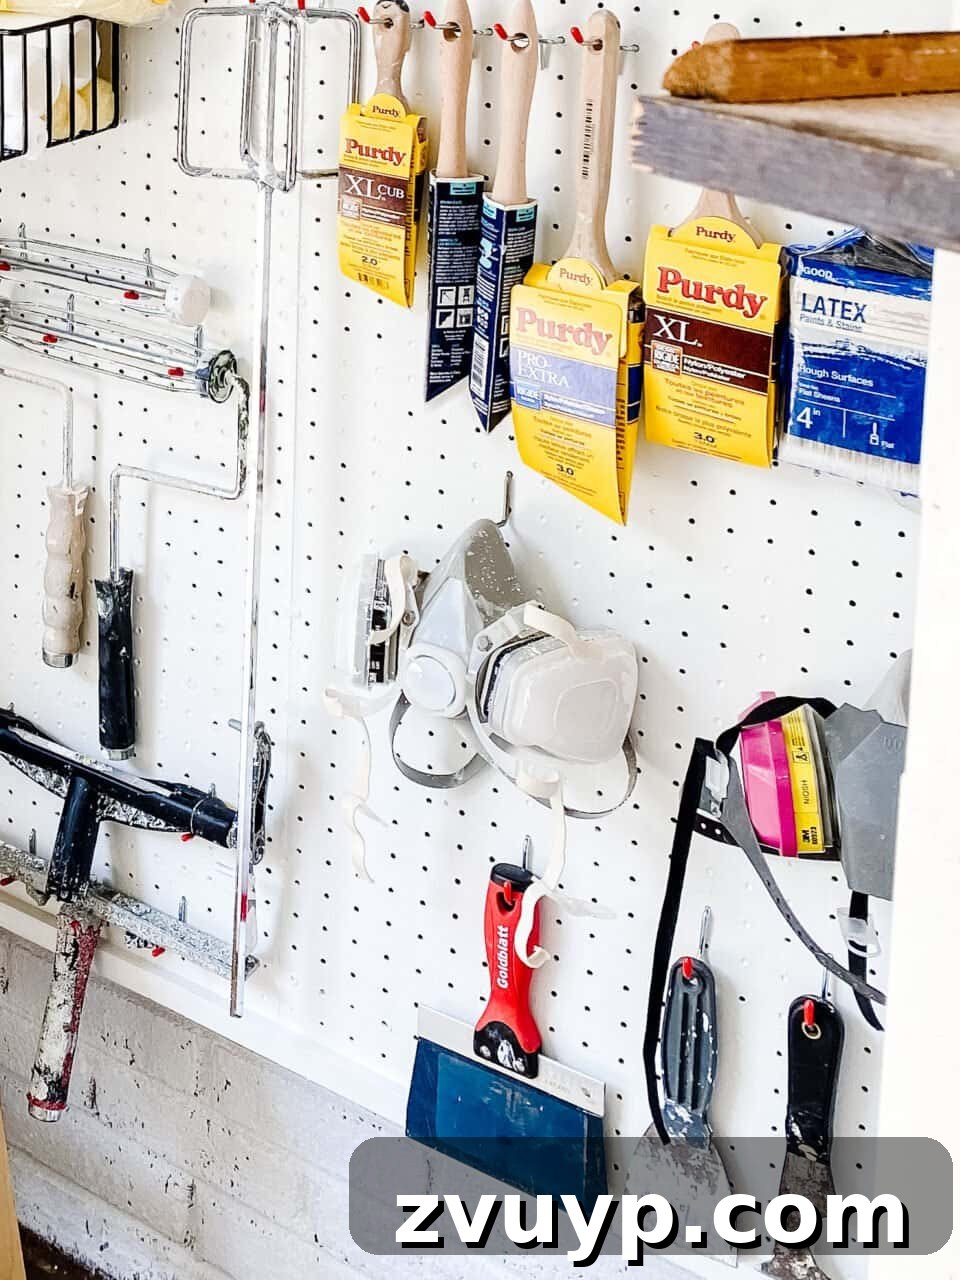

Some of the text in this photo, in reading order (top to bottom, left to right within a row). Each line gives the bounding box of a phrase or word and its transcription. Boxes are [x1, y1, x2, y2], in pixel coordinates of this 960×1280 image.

[372, 104, 400, 118] Purdy
[345, 138, 407, 166] Purdy
[344, 174, 406, 201] XL CUB
[695, 226, 737, 244] Purdy
[362, 256, 378, 266] 2.0
[558, 268, 593, 287] Purdy
[656, 266, 768, 320] Purdy
[800, 292, 868, 324] LATEX
[516, 306, 613, 356] Purdy
[652, 314, 698, 346] XL
[517, 350, 550, 368] PRO-
[518, 366, 570, 388] EXTRA
[830, 370, 874, 388] Surfaces
[799, 387, 812, 397] Flat
[796, 406, 821, 430] 4 in
[693, 431, 716, 444] 3.0
[880, 440, 895, 450] Flat
[556, 463, 575, 477] 3.0
[800, 779, 810, 805] NIOSH
[802, 830, 810, 844] 3M
[496, 925, 509, 989] Goldblatt
